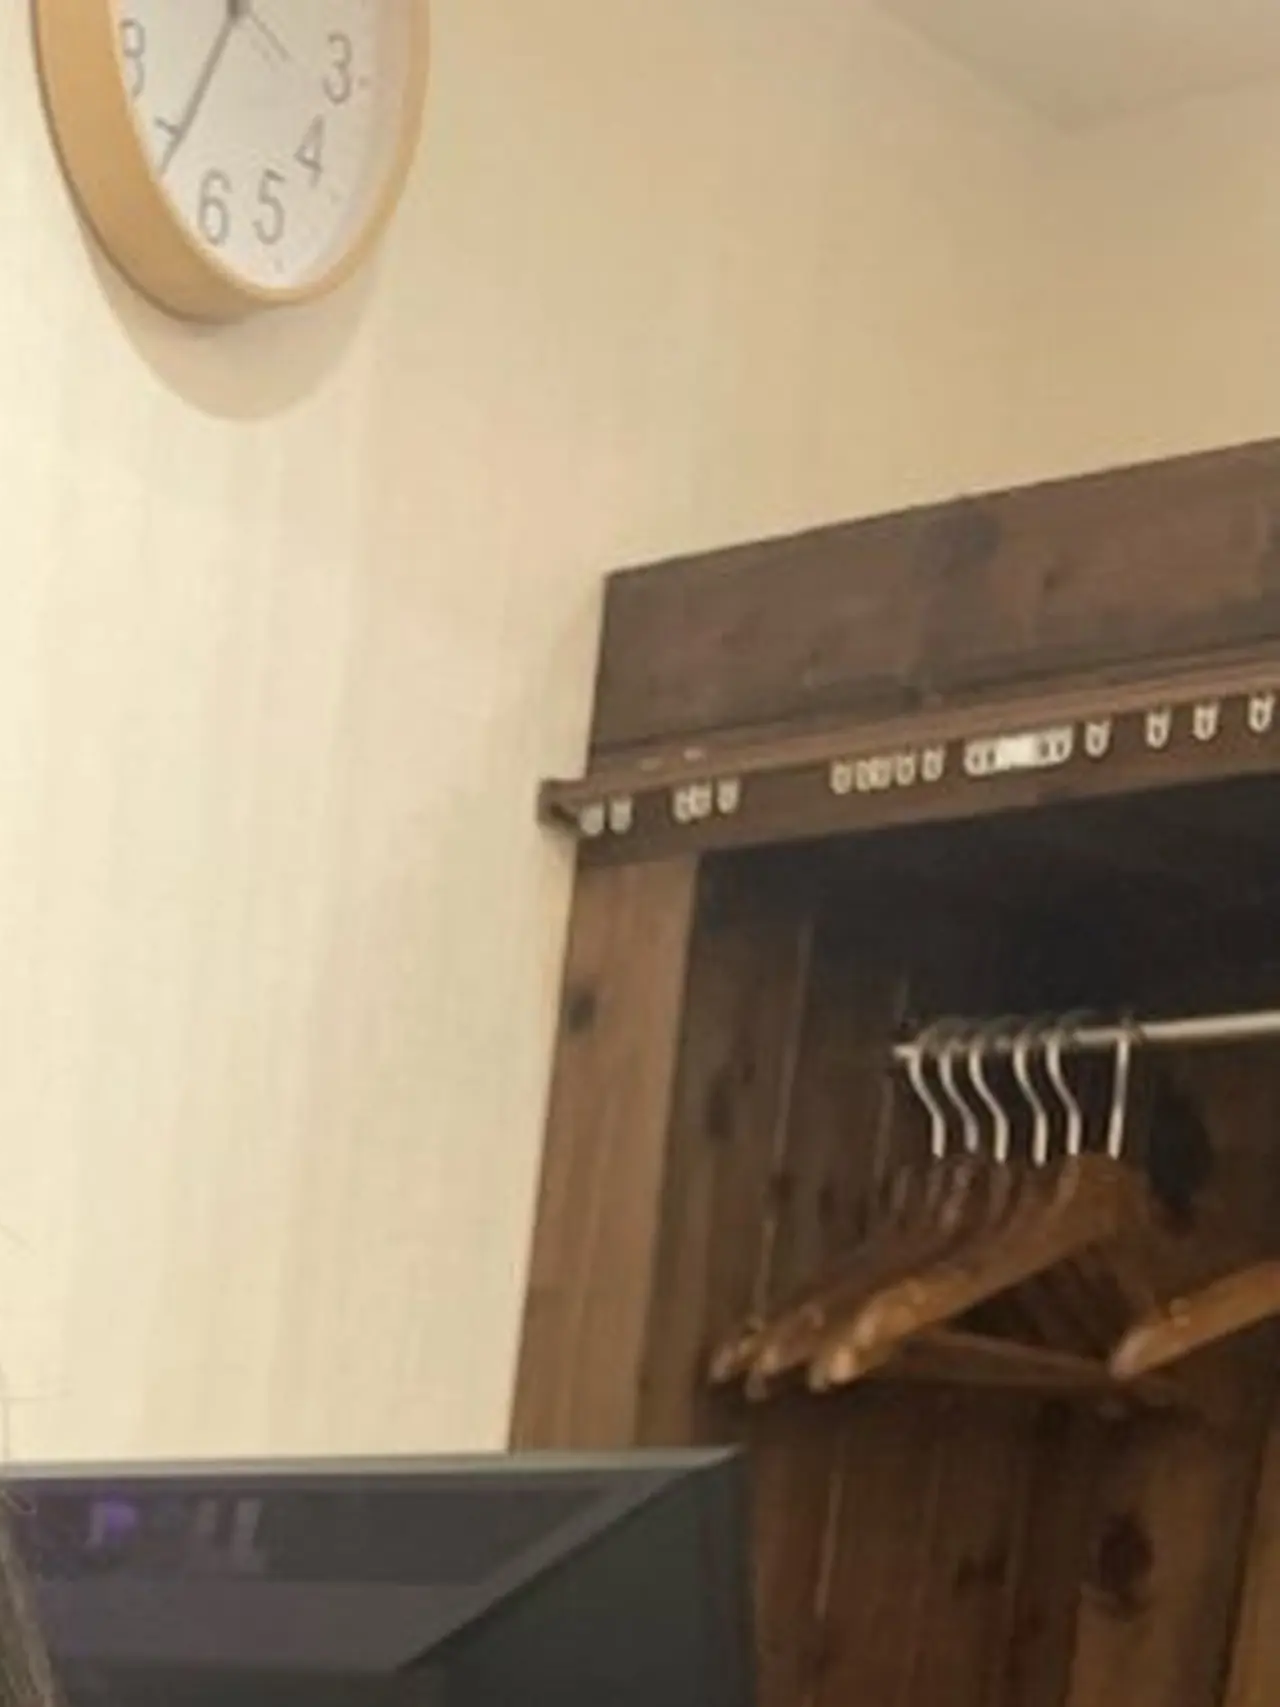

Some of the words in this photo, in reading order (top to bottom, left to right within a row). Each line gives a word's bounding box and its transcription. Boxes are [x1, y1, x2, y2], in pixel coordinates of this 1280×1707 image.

[322, 30, 353, 105] 3
[293, 114, 325, 188] 4
[196, 169, 233, 246] 6
[252, 169, 286, 246] 5
